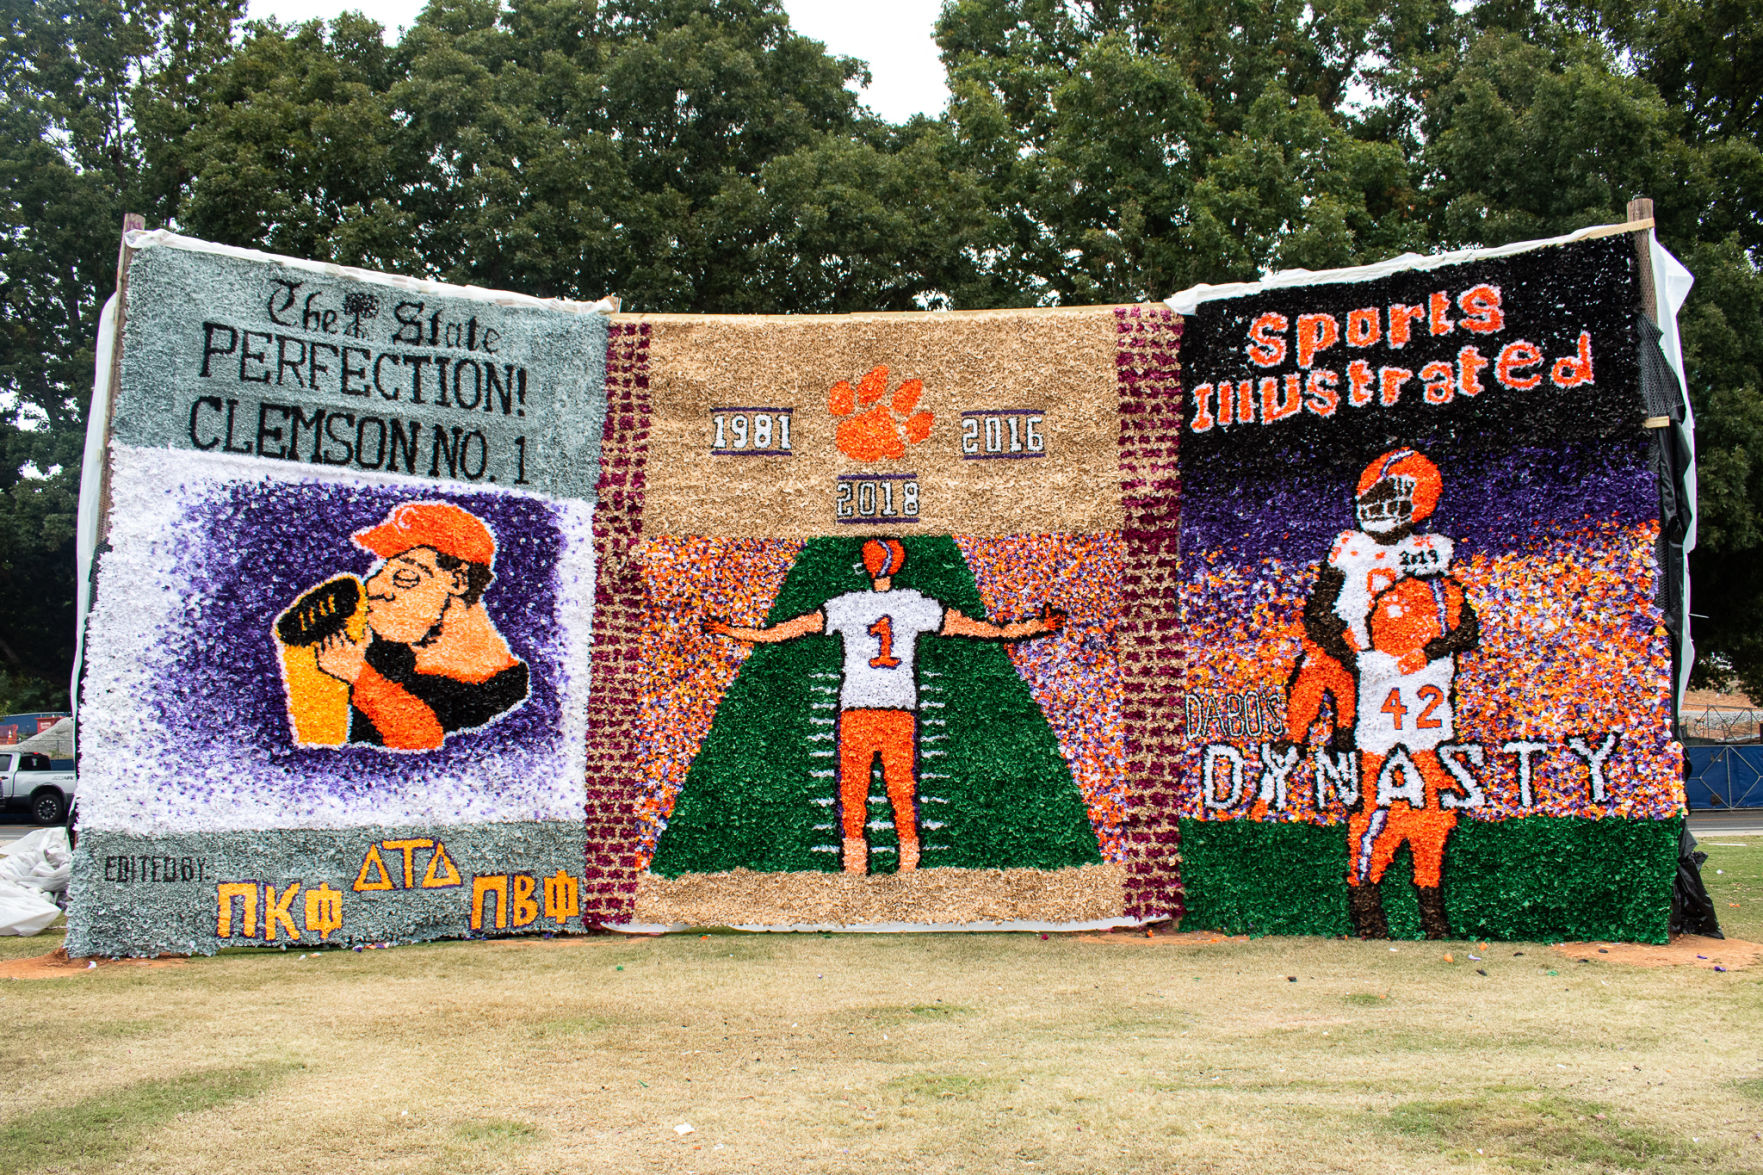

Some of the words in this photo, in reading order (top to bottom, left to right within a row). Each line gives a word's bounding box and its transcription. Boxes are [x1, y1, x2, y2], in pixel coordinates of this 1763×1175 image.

[269, 279, 337, 334] The
[392, 300, 501, 353] State
[200, 320, 528, 416] PERFECTION!
[1190, 330, 1595, 433] Illustrated
[189, 396, 423, 475] CLEMSON
[428, 423, 497, 482] NO.
[512, 435, 530, 485] 1
[711, 413, 792, 450] 1981
[961, 416, 1044, 453] 2016
[836, 481, 920, 517] 2018
[867, 613, 902, 669] 1
[1380, 684, 1444, 731] 42
[1201, 731, 1622, 812] DYNASTY
[105, 856, 176, 882] EDITED
